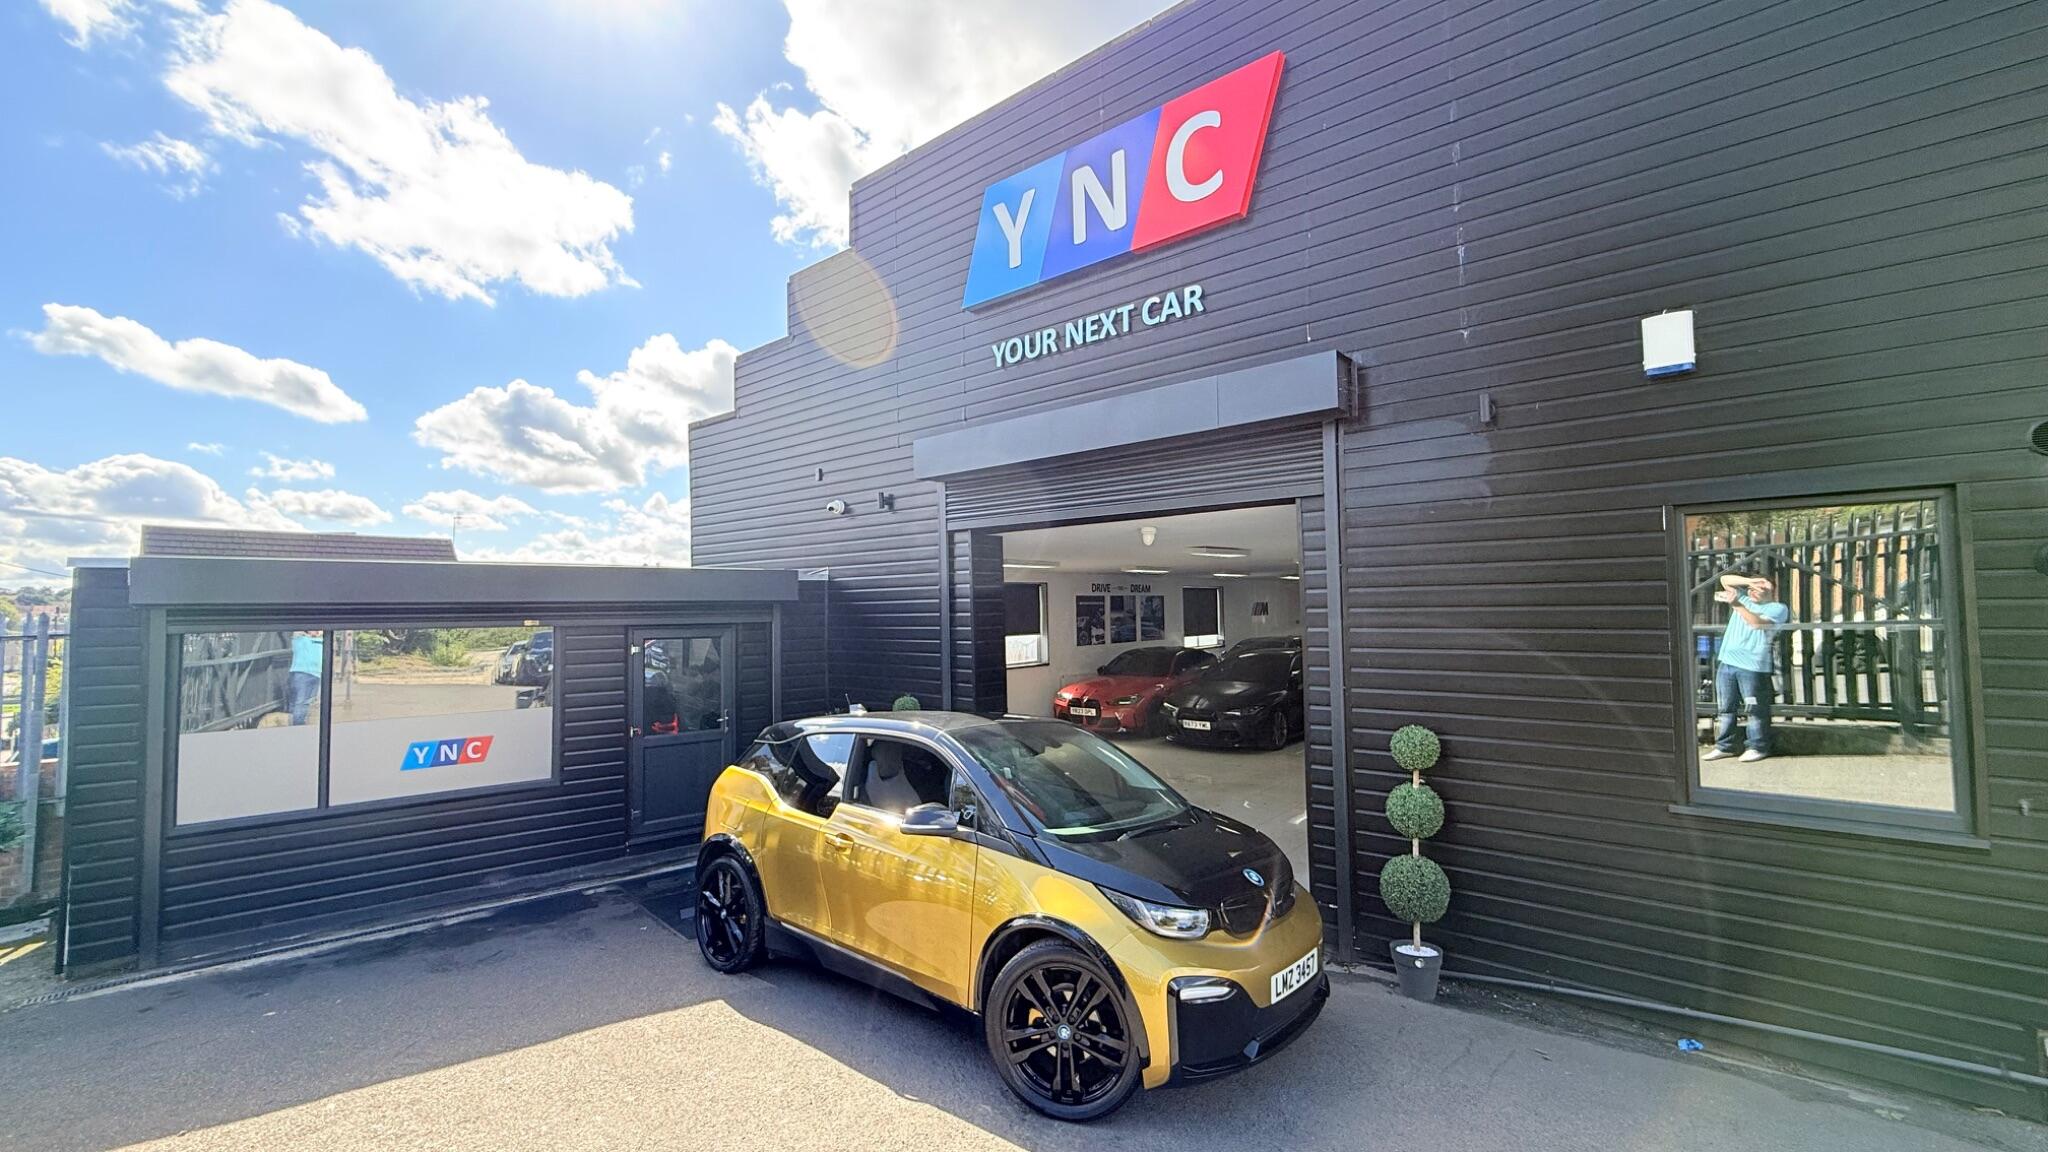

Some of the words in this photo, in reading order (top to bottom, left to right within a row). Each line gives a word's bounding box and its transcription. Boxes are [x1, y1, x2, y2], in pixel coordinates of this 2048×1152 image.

[993, 110, 1223, 268] YNC
[992, 328, 1057, 367] YOUR
[1065, 304, 1134, 348] NEXT
[1141, 284, 1204, 326] CAR
[1091, 583, 1111, 593] DRIVE
[1130, 584, 1151, 593] DREAM
[413, 741, 482, 764] YNC
[1275, 968, 1294, 998] LMZ
[1296, 953, 1315, 984] 3457
